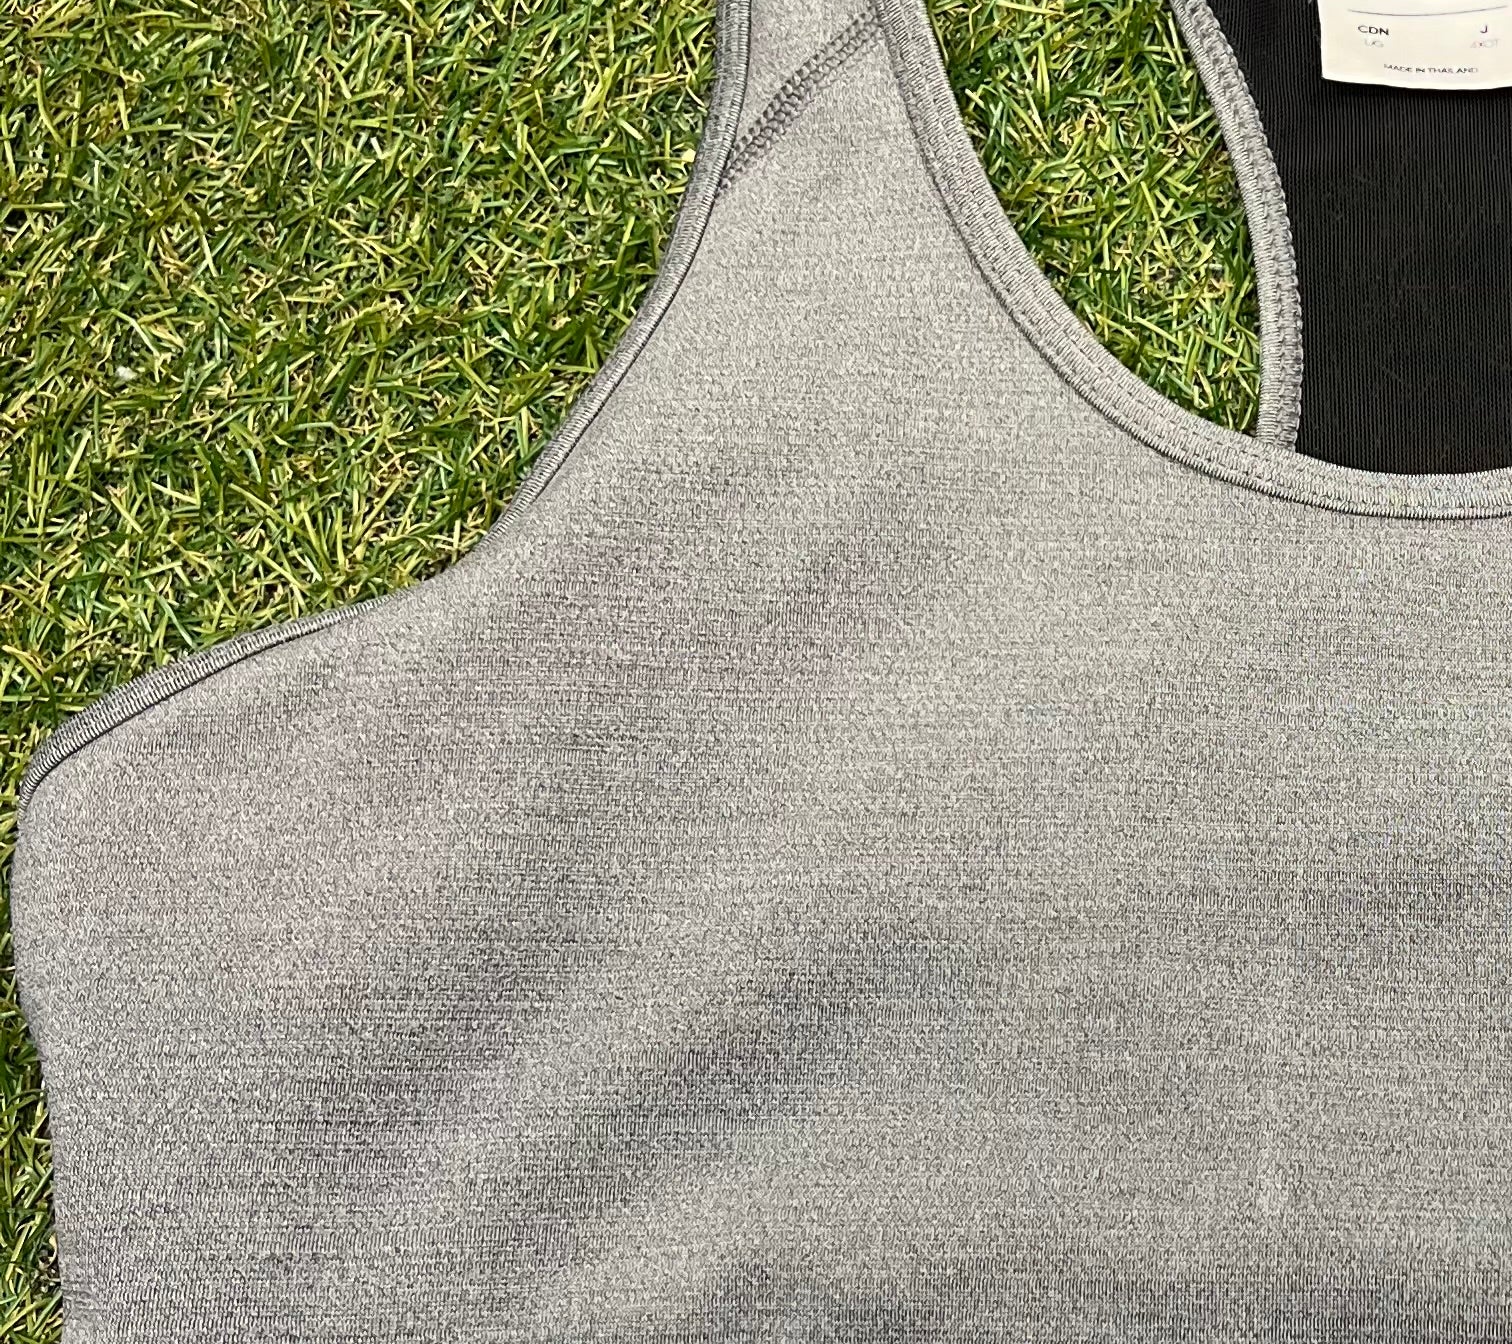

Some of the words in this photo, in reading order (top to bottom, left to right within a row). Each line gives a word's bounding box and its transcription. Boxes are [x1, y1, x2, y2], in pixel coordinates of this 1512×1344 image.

[1358, 25, 1390, 35] CDN
[1480, 25, 1488, 34] J
[1384, 63, 1413, 73] MADE
